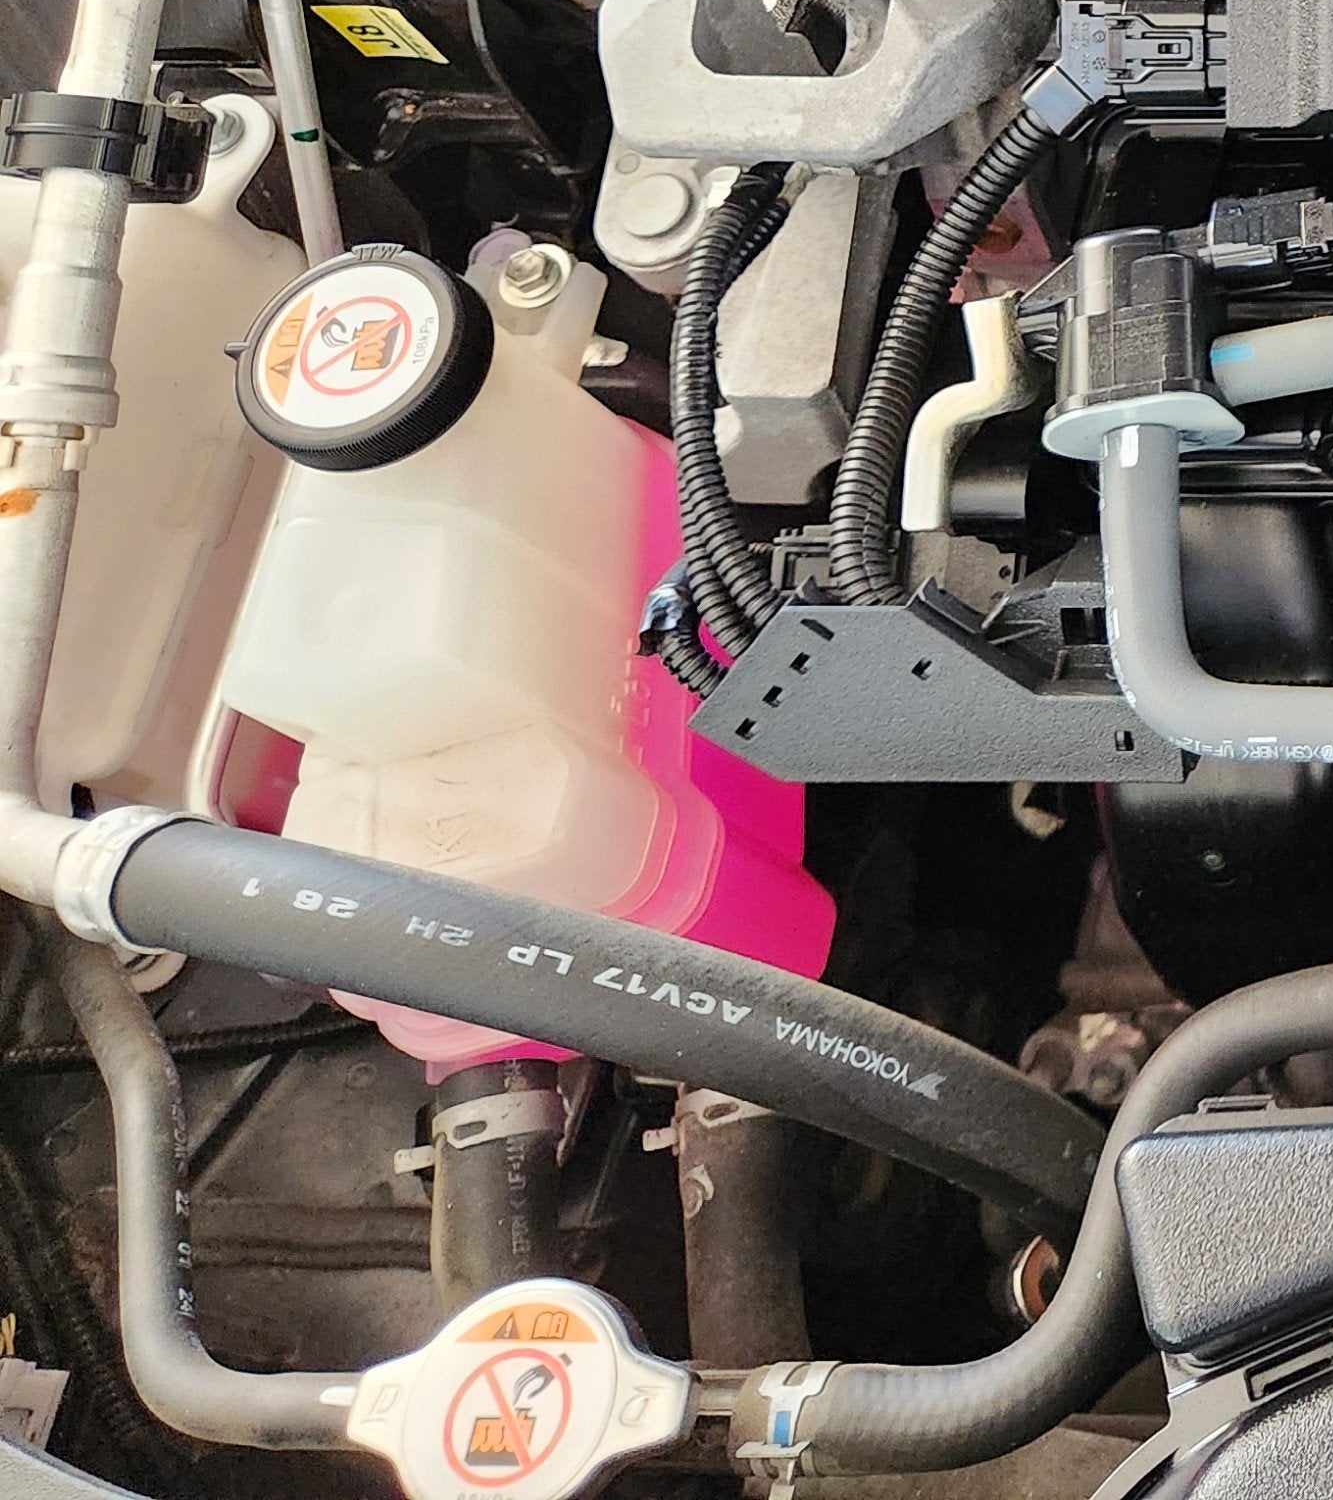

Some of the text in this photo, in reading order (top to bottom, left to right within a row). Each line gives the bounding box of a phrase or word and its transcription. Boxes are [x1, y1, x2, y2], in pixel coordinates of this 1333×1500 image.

[354, 244, 399, 261] ITW
[412, 316, 435, 364] 108kPa
[404, 914, 475, 948] 2H
[506, 942, 575, 978] LP
[590, 965, 752, 1026] ACV17
[775, 1015, 911, 1088] YOKOHAMA
[175, 1189, 190, 1218] 22
